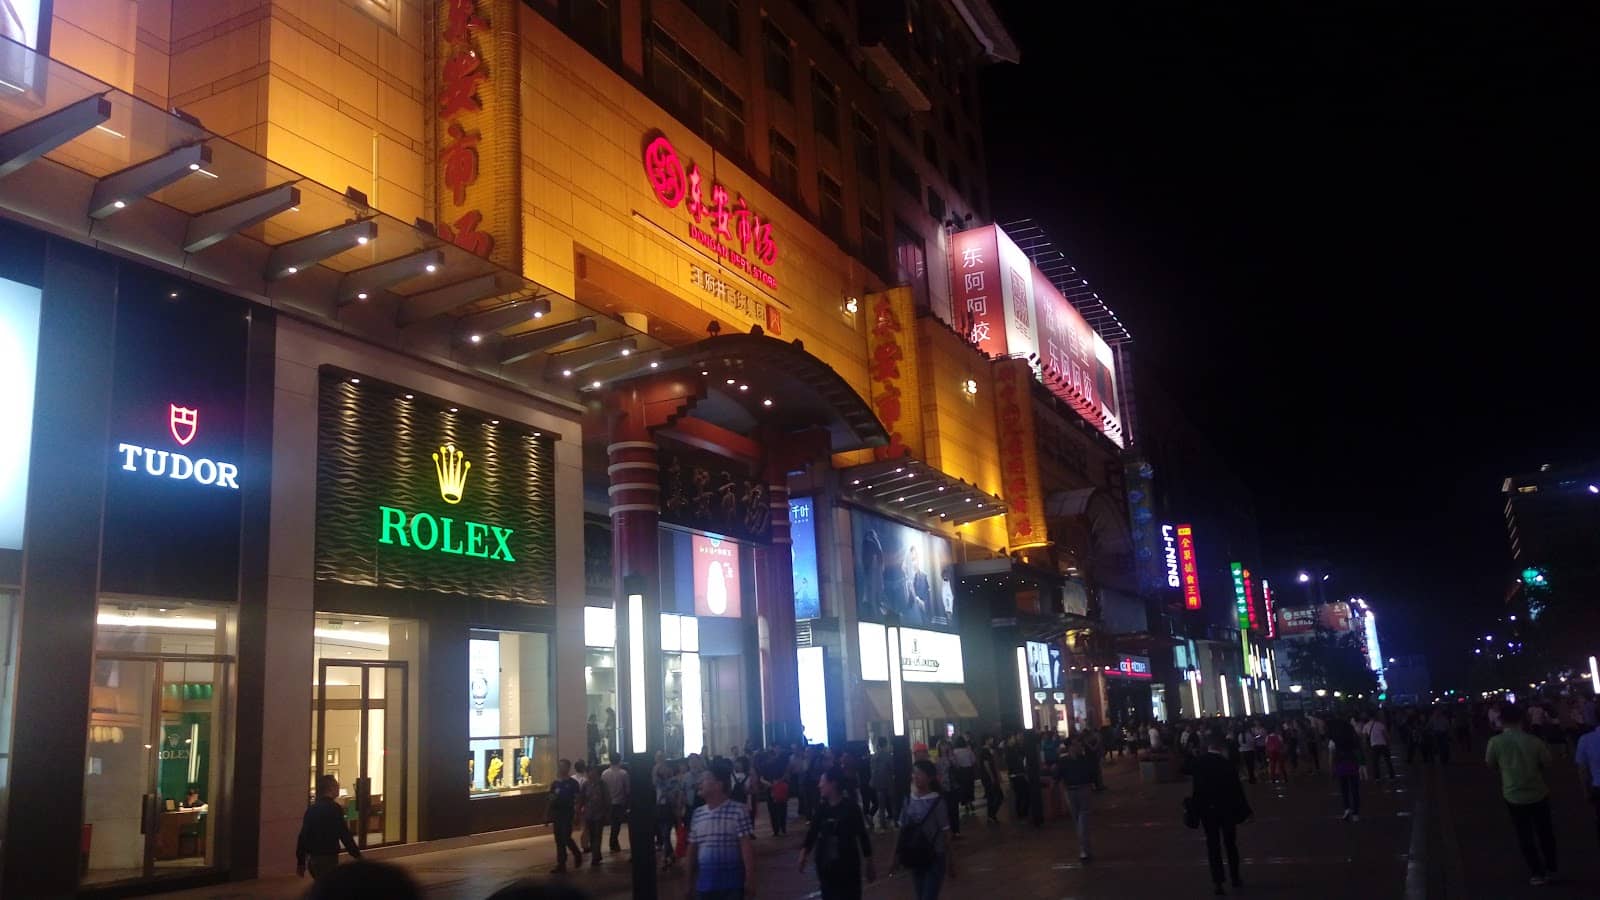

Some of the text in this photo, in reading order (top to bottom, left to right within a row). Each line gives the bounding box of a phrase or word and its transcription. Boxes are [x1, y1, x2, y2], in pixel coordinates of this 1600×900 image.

[690, 225, 729, 259] DONGAN
[752, 264, 778, 290] STORE
[118, 442, 240, 489] TUDOR
[378, 505, 516, 562] ROLEX
[1161, 524, 1181, 588] LI-NING
